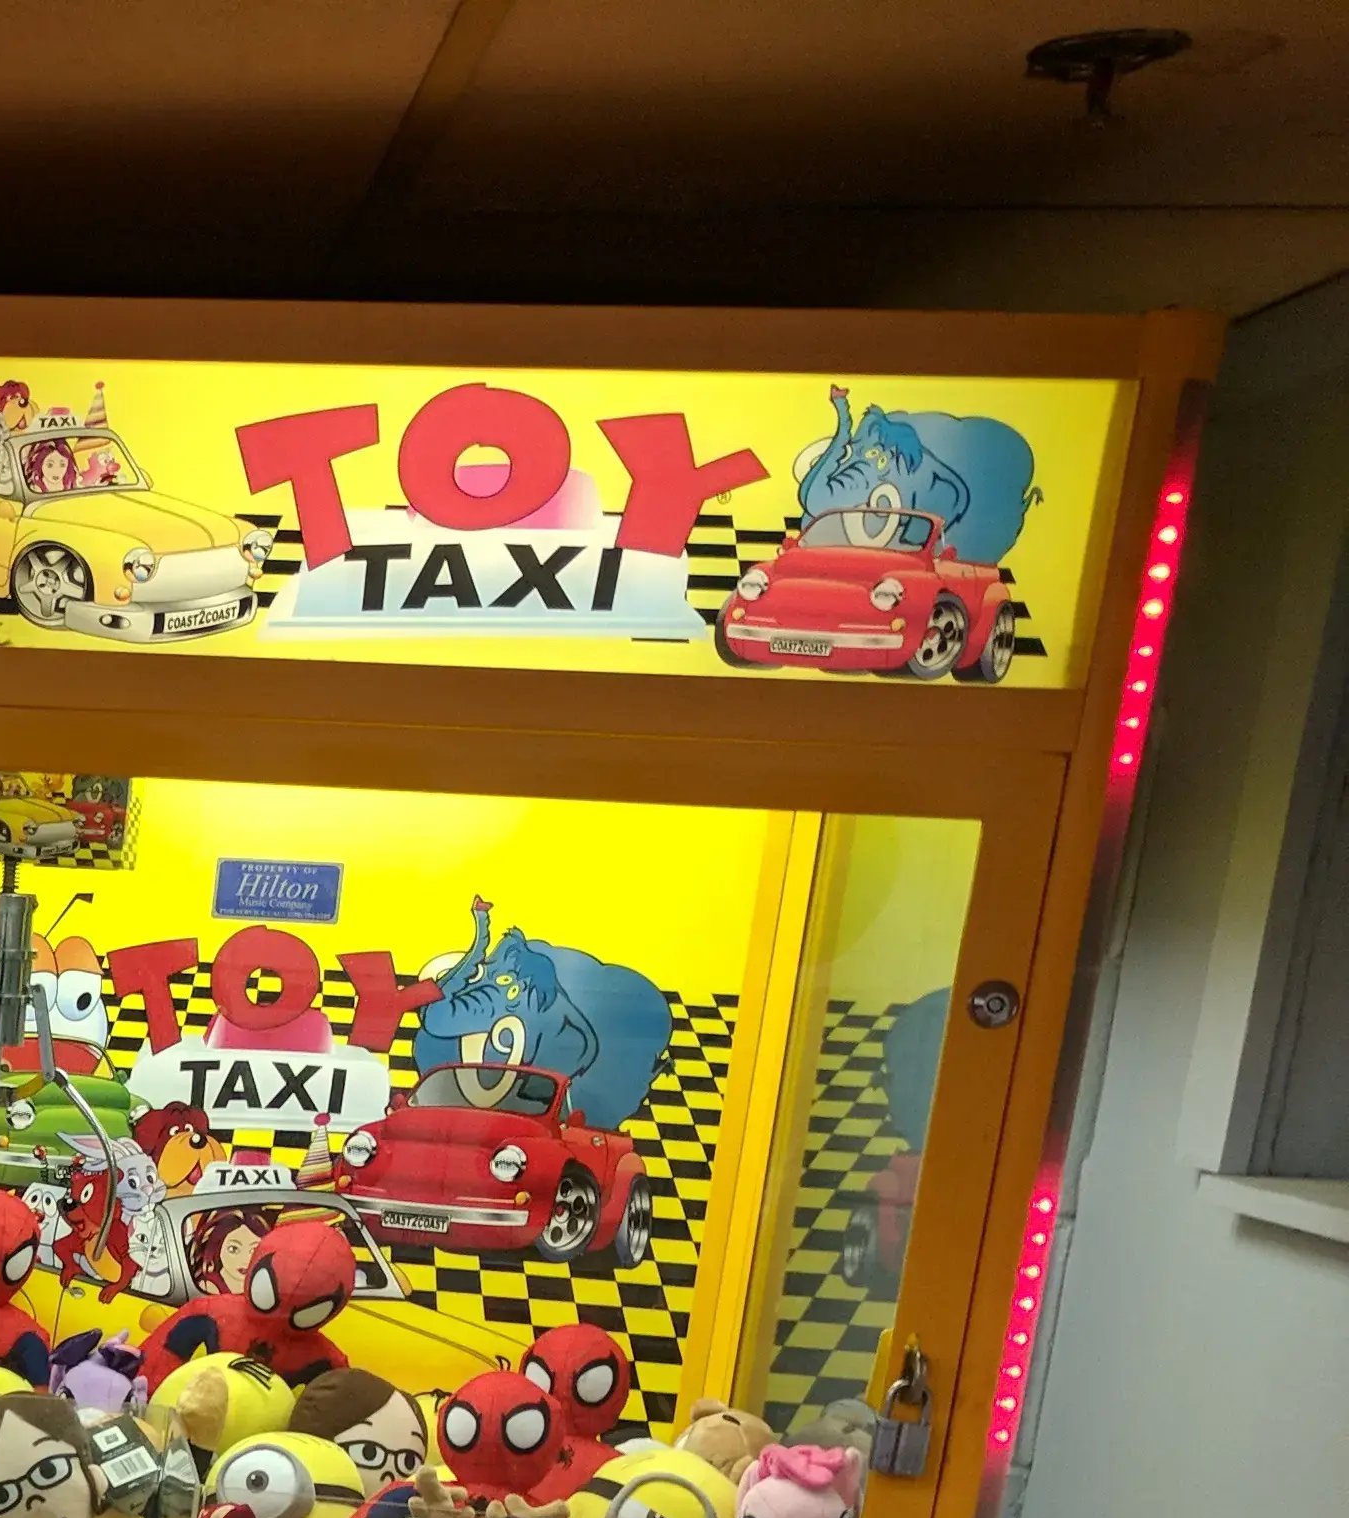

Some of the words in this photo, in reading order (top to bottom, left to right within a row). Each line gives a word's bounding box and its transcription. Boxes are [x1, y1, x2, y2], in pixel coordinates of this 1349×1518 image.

[38, 416, 77, 429] TAXI
[235, 382, 770, 571] TOY
[345, 543, 623, 612] TAXI
[167, 605, 238, 631] COAST2COAST
[241, 863, 299, 875] PROPERTY
[304, 867, 318, 875] OF
[235, 872, 319, 901] Hilton
[238, 896, 267, 908] Music
[269, 898, 314, 911] Company
[107, 925, 445, 1056] TOY
[180, 1060, 348, 1115] TAXI
[216, 1168, 281, 1186] TAXI
[383, 1214, 448, 1232] COAST2COAST
